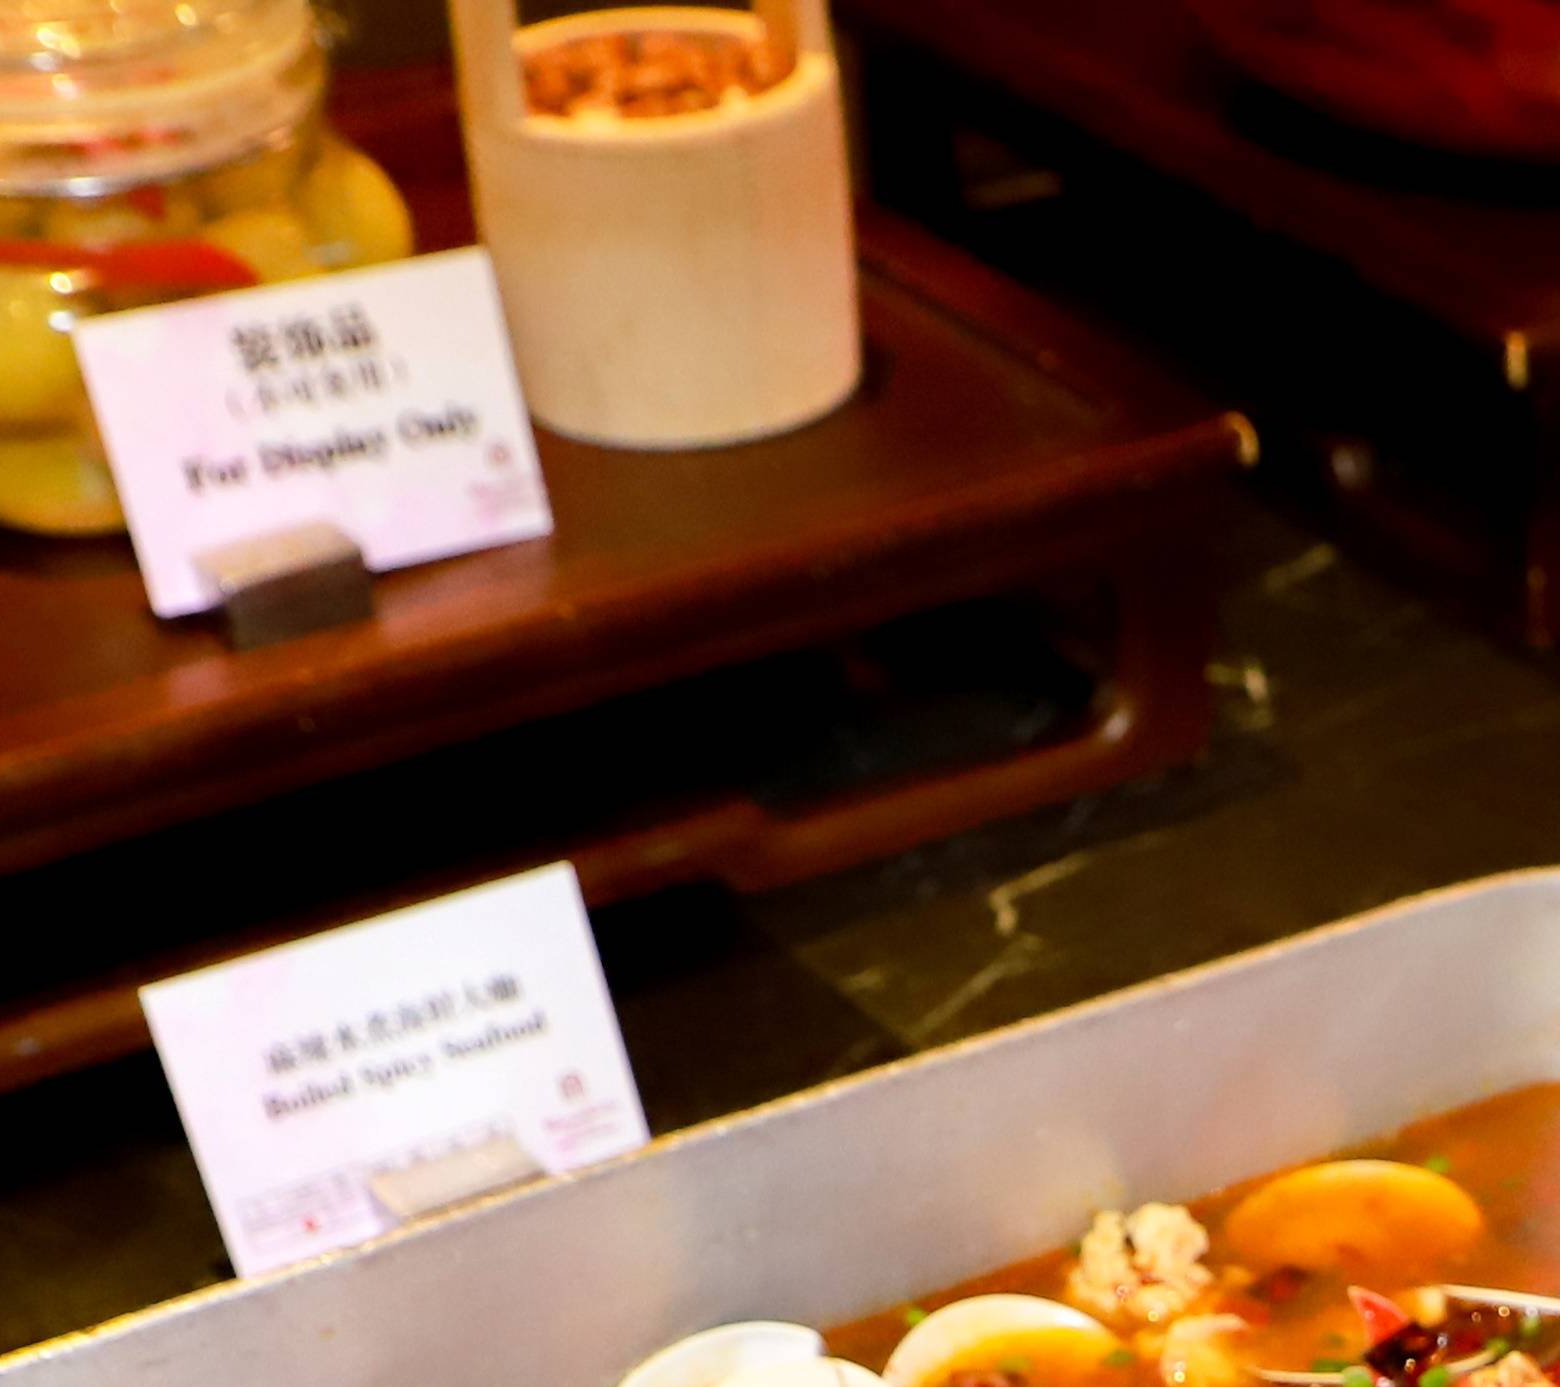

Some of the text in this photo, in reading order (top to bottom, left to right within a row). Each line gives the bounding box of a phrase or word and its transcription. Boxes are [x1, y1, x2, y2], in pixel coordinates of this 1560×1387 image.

[183, 403, 479, 492] For Display Only
[263, 1069, 354, 1121] Boiled
